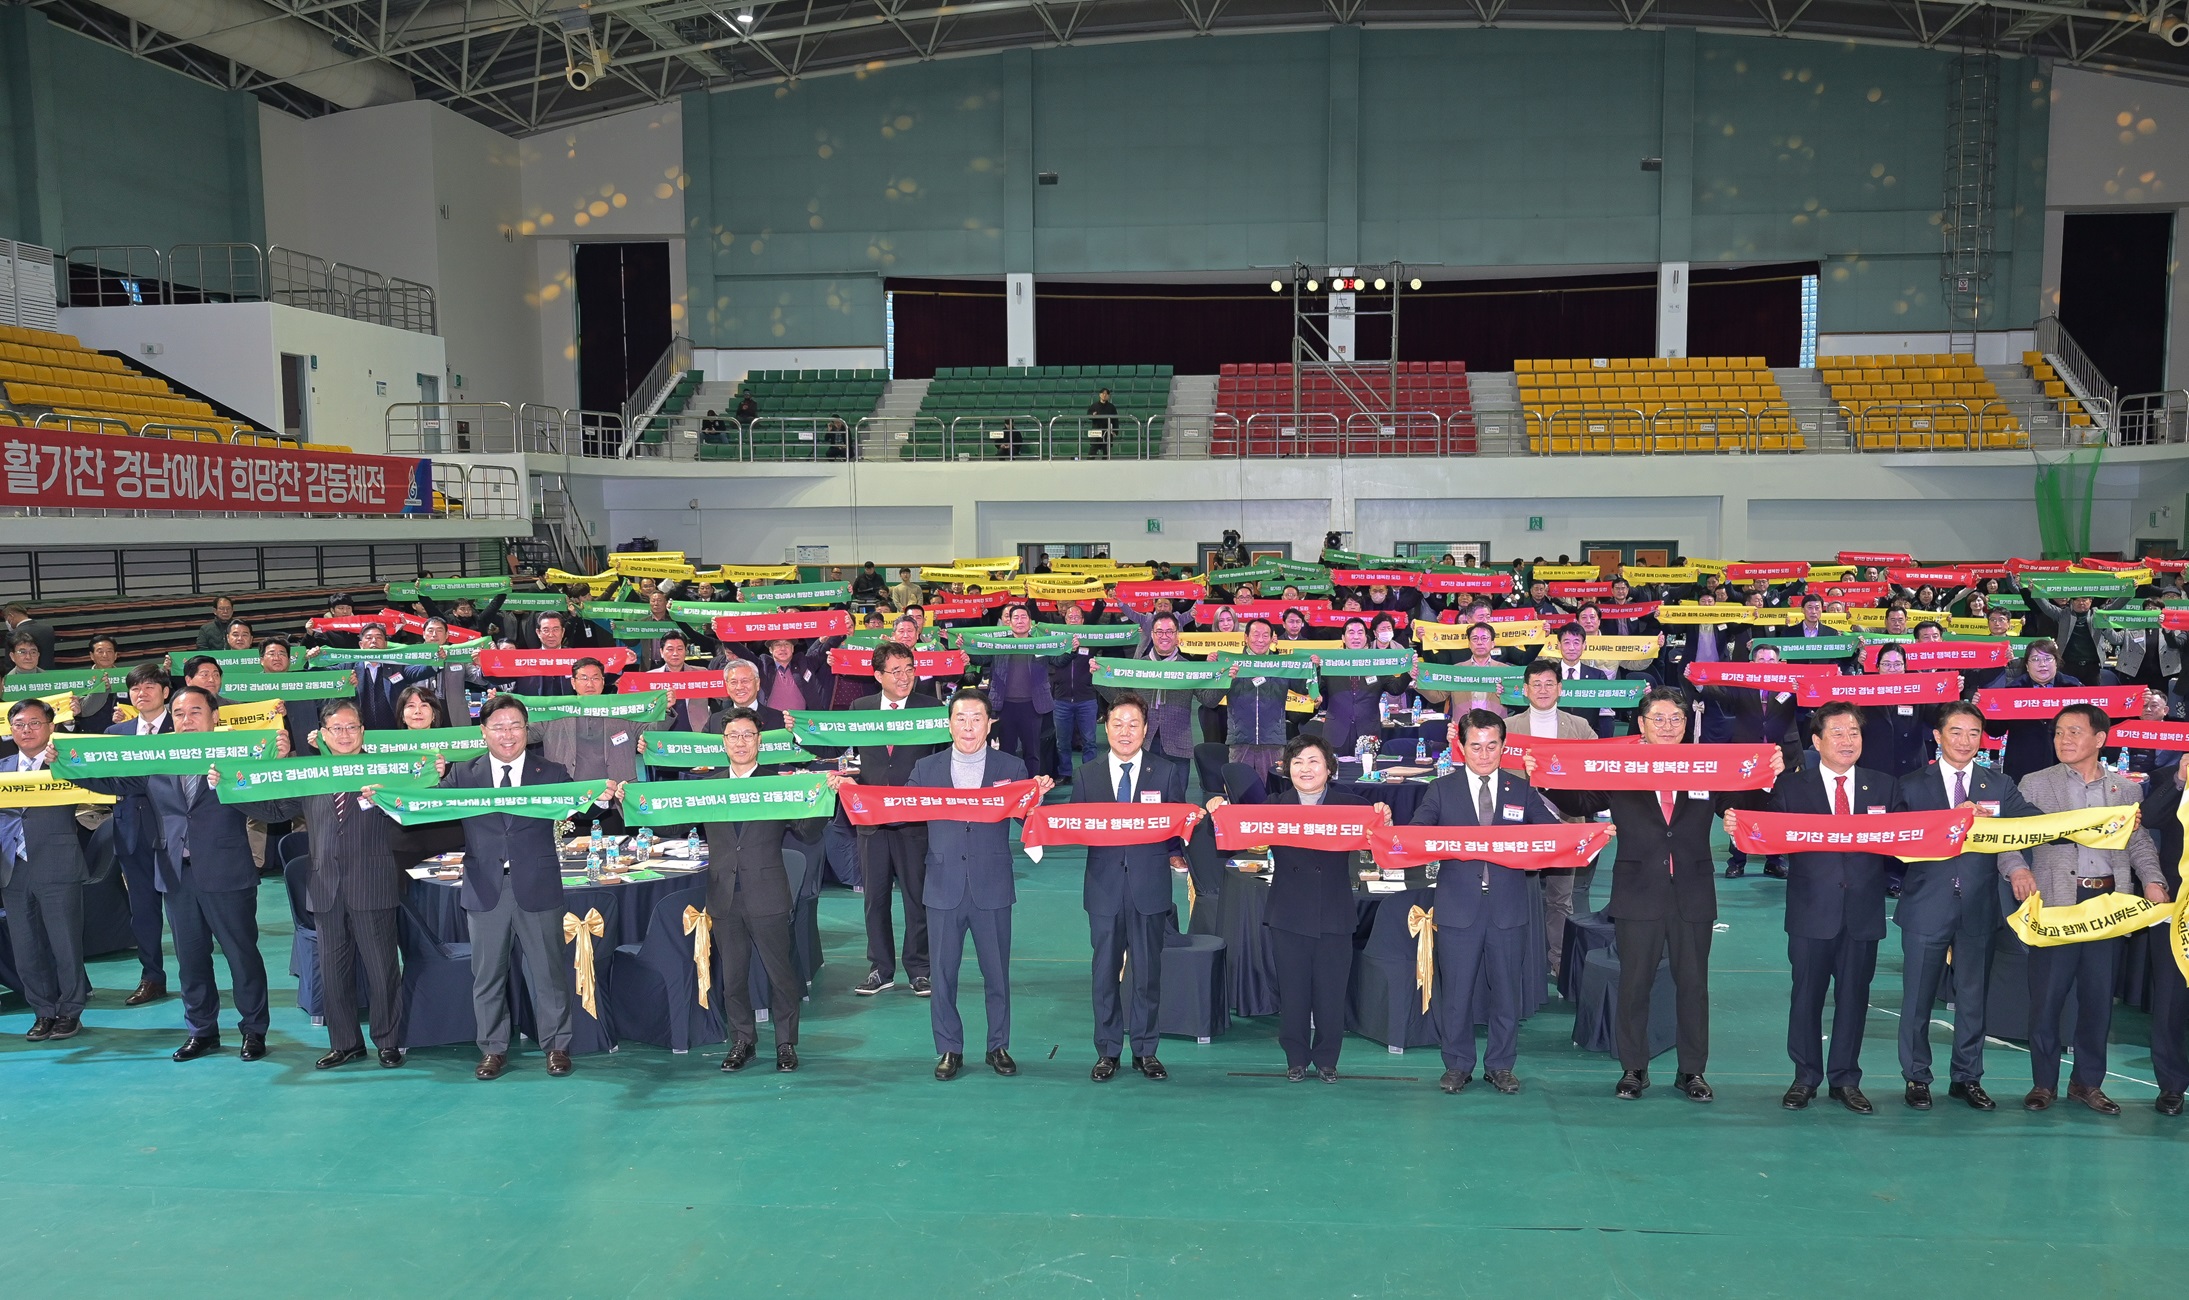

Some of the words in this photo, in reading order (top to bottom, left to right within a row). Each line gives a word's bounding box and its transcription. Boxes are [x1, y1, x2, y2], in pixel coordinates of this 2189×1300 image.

[4, 439, 104, 496] 활기찬
[114, 450, 224, 500] 경남에서
[231, 457, 300, 502] 희망찬
[305, 463, 385, 504] 감동체전
[1326, 658, 1350, 666] 경남에서
[1352, 658, 1371, 666] 희망찬
[1373, 657, 1399, 665] 감동체전
[1114, 669, 1134, 677] 활기찬
[1136, 670, 1161, 678] 경남에서
[1721, 673, 1744, 681] 활기찬
[225, 684, 247, 692] 활기찬
[250, 683, 279, 691] 경남에서
[1575, 689, 1596, 697] 희망찬
[1858, 687, 1875, 695] 경남
[1877, 686, 1902, 694] 행복한
[2014, 700, 2040, 708] 활기찬
[2042, 699, 2059, 707] 경남
[2091, 698, 2108, 706] 도민
[584, 707, 609, 716] 희망찬
[611, 704, 644, 714] 감동체전
[230, 714, 265, 725] 대한민국
[819, 722, 846, 732] 활기찬
[848, 720, 884, 732] 경남에서
[887, 719, 914, 731] 희망찬
[916, 717, 949, 730] 감동체전
[2117, 730, 2139, 738] 활기찬
[2142, 731, 2158, 739] 경남
[2160, 732, 2183, 741] 행복한
[380, 743, 417, 752] 경남에서
[421, 740, 448, 751] 희망찬
[451, 738, 487, 749] 감동체전
[667, 743, 691, 754] 활기찬
[694, 743, 725, 754] 경남에서
[758, 742, 790, 751] 감동체전
[84, 751, 117, 762] 활기찬
[121, 750, 165, 760] 경남에서
[169, 748, 201, 759] 희망찬
[205, 746, 248, 757] 감동체전
[1584, 760, 1621, 772] 활기찬
[1624, 761, 1649, 773] 경남
[1652, 761, 1689, 773] 행복한
[1692, 760, 1717, 773] 도민
[250, 772, 282, 784] 활기찬
[286, 769, 329, 781] 경남에서
[332, 765, 364, 776] 희망찬
[367, 763, 408, 775] 감동체전
[651, 797, 682, 810] 활기찬
[686, 794, 726, 807] 경남에서
[729, 792, 760, 805] 희망찬
[763, 791, 804, 802] 감동체전
[883, 796, 917, 807] 활기찬
[920, 796, 942, 806] 경남
[945, 797, 979, 806] 행복한
[982, 797, 1004, 807] 도민
[1048, 817, 1081, 829] 활기찬
[1085, 819, 1107, 830] 경남
[1110, 818, 1144, 830] 행복한
[1148, 817, 1170, 829] 도민
[1240, 821, 1274, 834] 활기찬
[1277, 823, 1300, 834] 경남
[1303, 824, 1337, 835] 행복한
[1340, 825, 1363, 836] 도민
[1785, 831, 1824, 842] 활기찬
[1827, 832, 1853, 843] 경남
[1856, 832, 1895, 843] 행복한
[1898, 829, 1924, 841] 도민
[1973, 834, 1998, 843] 함께
[2003, 834, 2053, 844] 다시뛰는
[1425, 840, 1461, 852] 활기찬
[1465, 841, 1489, 852] 경남
[1492, 841, 1528, 852] 행복한
[1532, 840, 1555, 851] 도민
[2062, 924, 2088, 936] 함께
[2090, 907, 2138, 930] 다시뛰는
